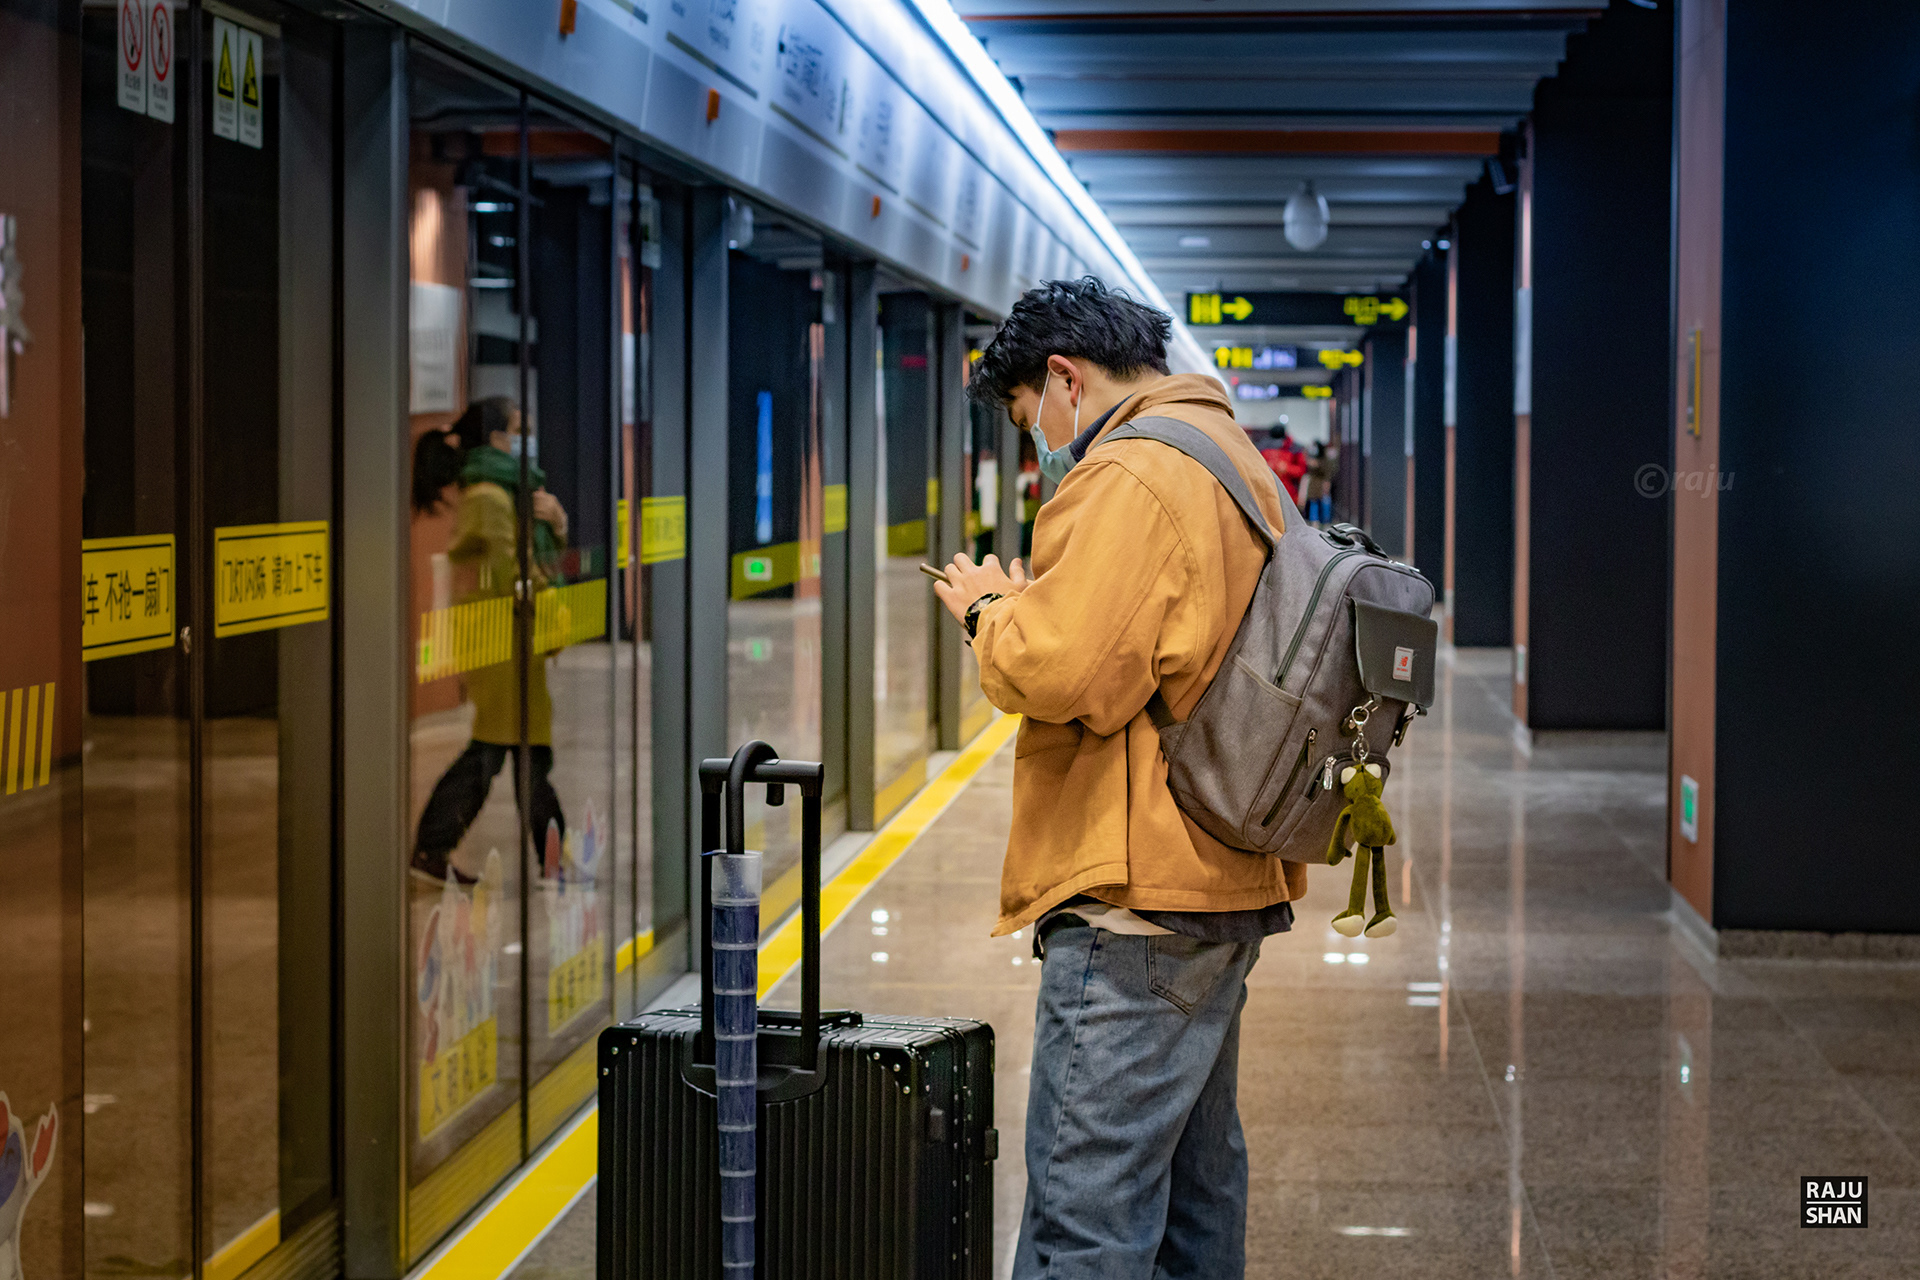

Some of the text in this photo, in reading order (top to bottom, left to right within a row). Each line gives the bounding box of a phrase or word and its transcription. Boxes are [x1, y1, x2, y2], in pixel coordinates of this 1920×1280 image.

[105, 566, 170, 622] 不抢一扇门
[221, 549, 323, 604] 门灯闪烁 请勿上下车
